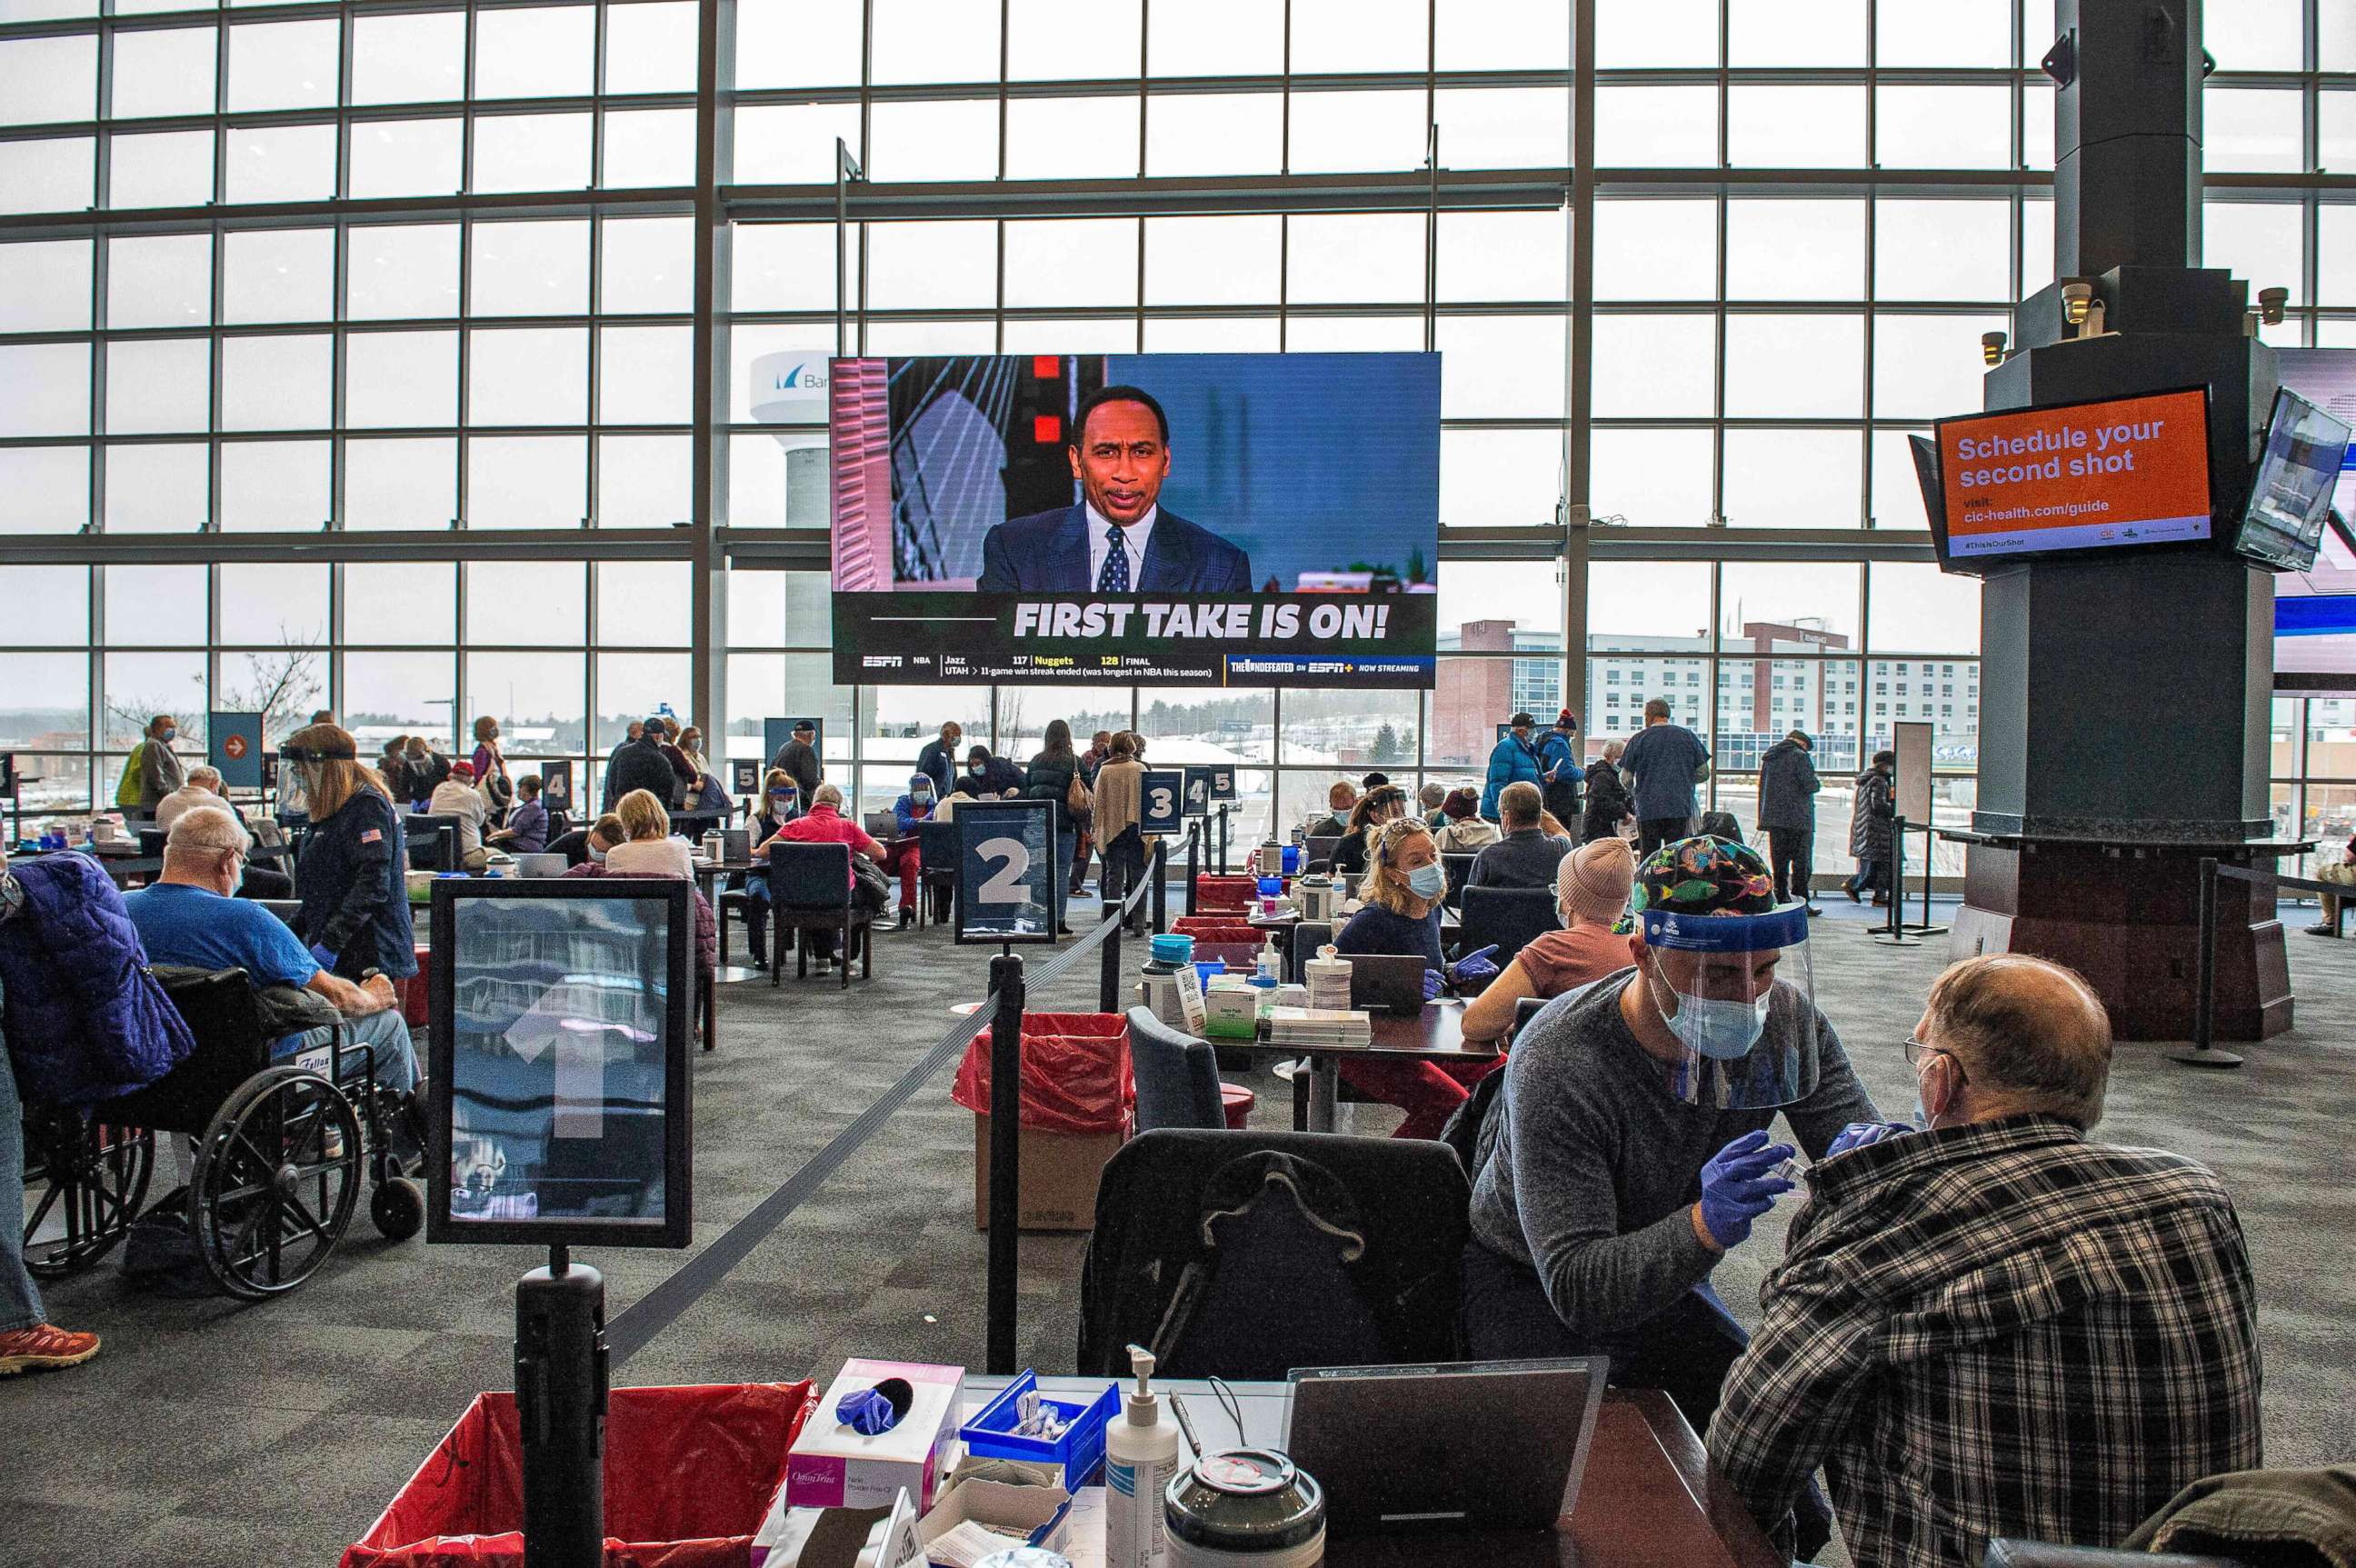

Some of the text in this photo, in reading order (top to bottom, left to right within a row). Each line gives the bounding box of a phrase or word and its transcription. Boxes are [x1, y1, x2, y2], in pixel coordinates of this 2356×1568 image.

[1958, 420, 2165, 460] Schedule your
[1960, 449, 2134, 487] second shot
[1963, 498, 1993, 508] visit:
[1963, 500, 2110, 523] cic-health.com/guide
[1965, 539, 2025, 549] #ThisIsOurShot
[1013, 603, 1390, 639] FIRST TAKE IS ON!
[863, 655, 931, 667] ESPN NBA
[944, 655, 1151, 667] Jazz 117 Nuggets 128 FINAL
[945, 666, 1213, 677] UTAH 11-game win streak ended (was longest in NBA this season)
[1308, 662, 1353, 673] ESPN+
[1377, 664, 1419, 673] STREAMING
[547, 774, 566, 797] 4
[739, 768, 754, 787] 5
[1214, 773, 1231, 791] 5
[1149, 787, 1173, 819] 3
[1189, 779, 1204, 804] 4
[975, 837, 1032, 904] 2
[503, 974, 604, 1138] 1
